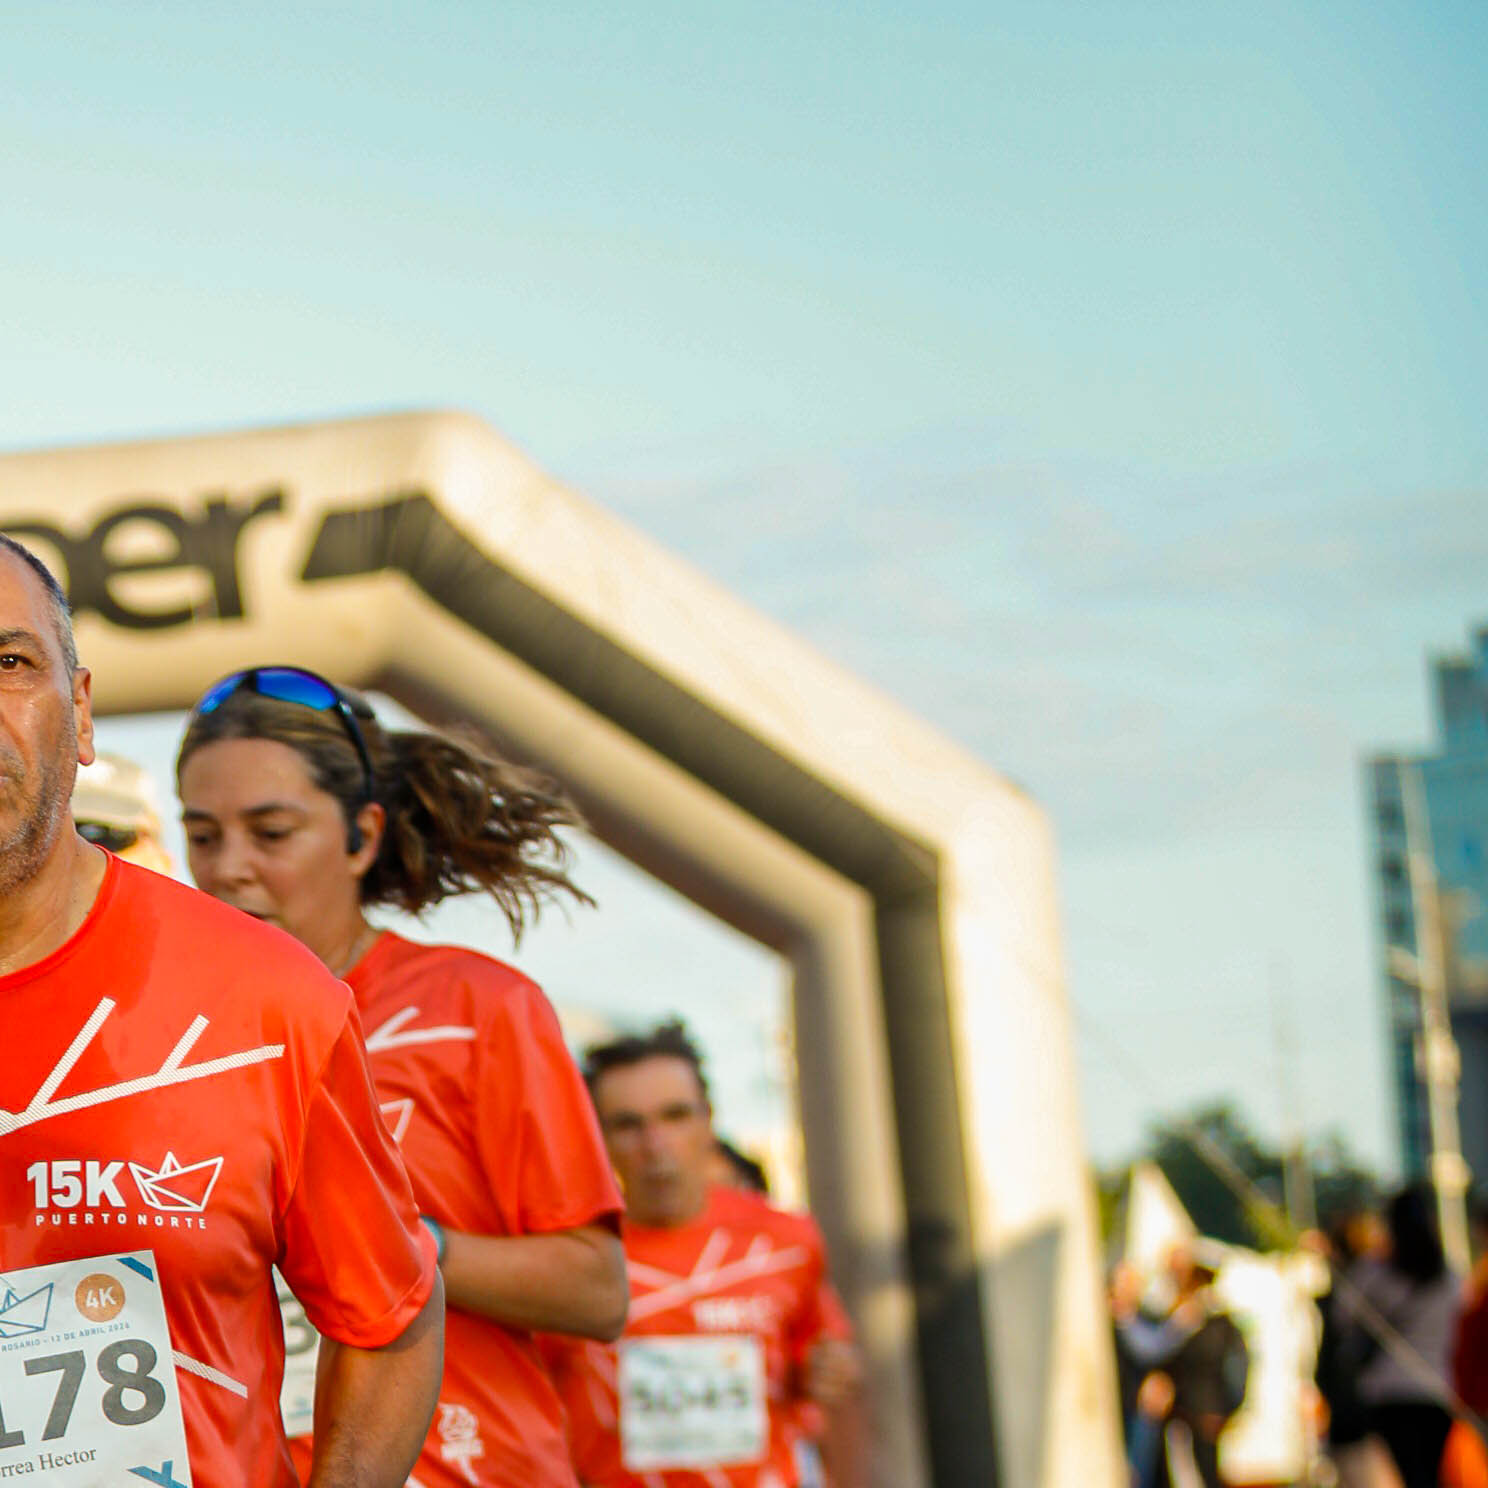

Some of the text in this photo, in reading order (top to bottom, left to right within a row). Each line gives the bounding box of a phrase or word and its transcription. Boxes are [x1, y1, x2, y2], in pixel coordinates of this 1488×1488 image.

[26, 1160, 127, 1209] 15K
[35, 1213, 207, 1230] PUERTO NORTE
[85, 1287, 116, 1309] 4K
[1, 1339, 41, 1353] ROSARIO
[63, 1331, 76, 1341] DE
[79, 1326, 106, 1338] ABRIL
[39, 1449, 97, 1470] Hector
